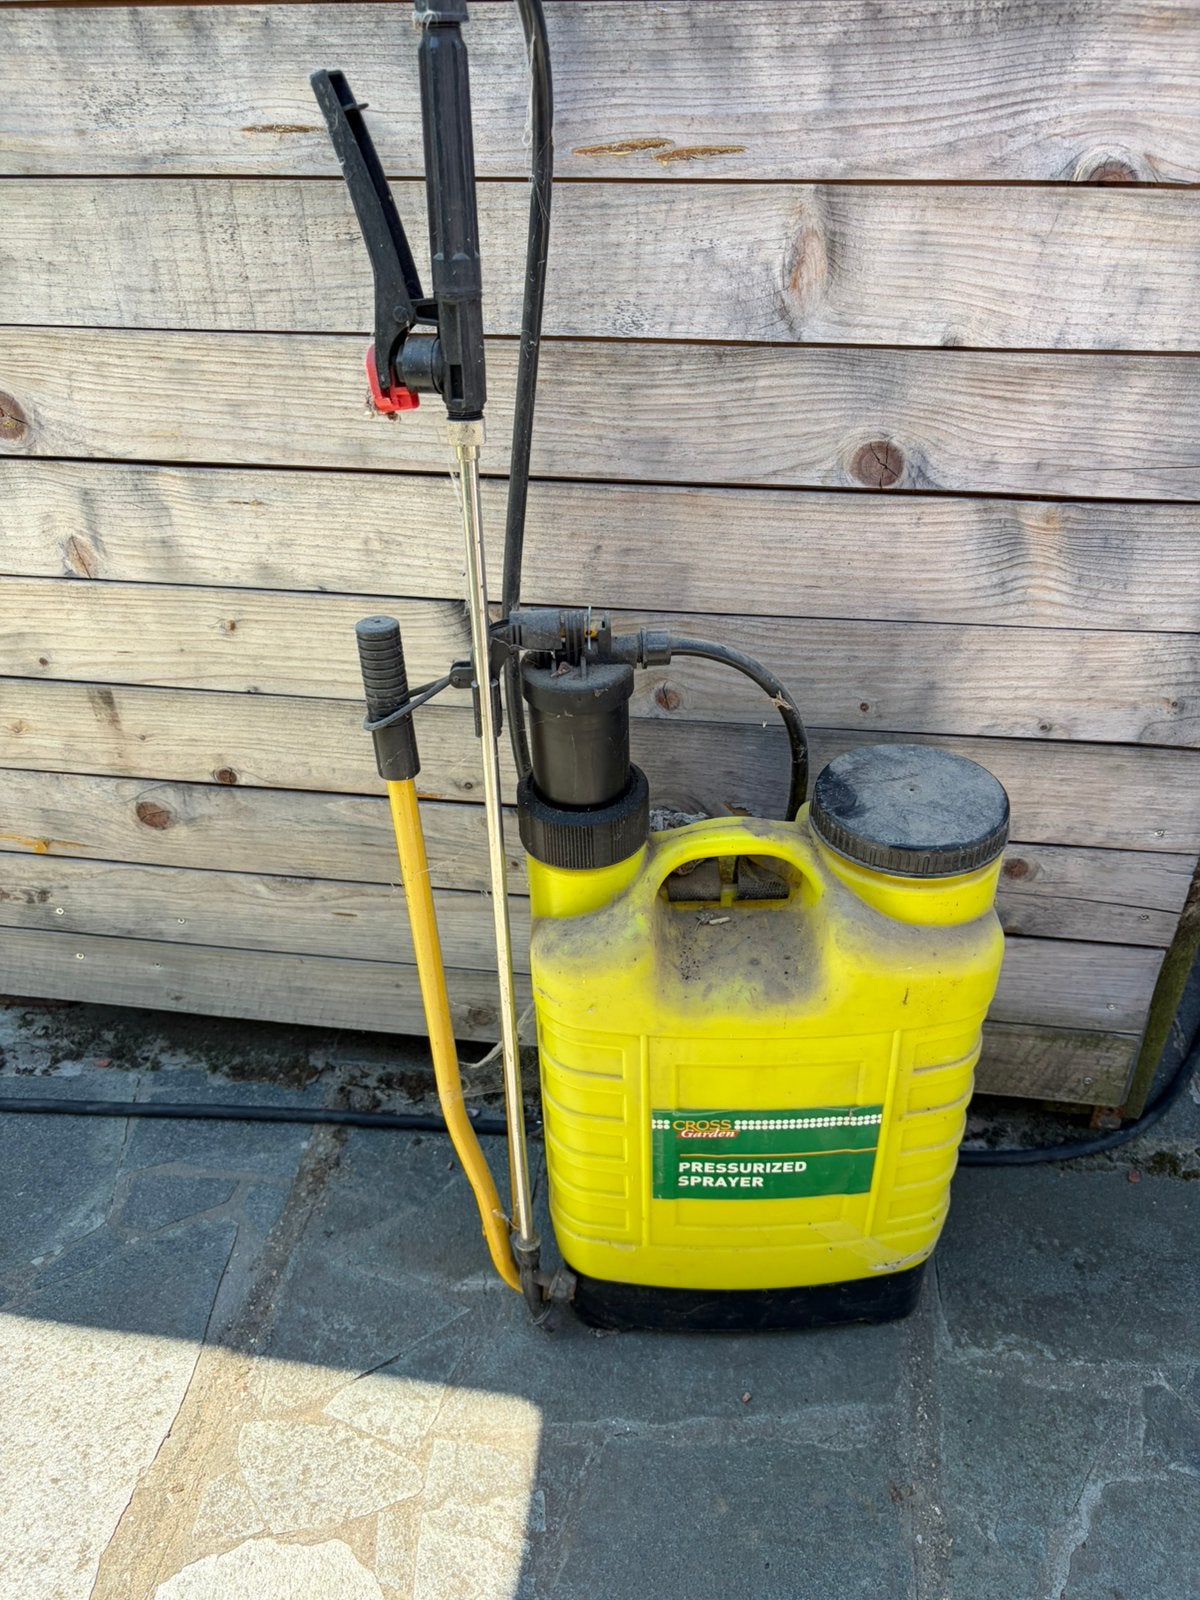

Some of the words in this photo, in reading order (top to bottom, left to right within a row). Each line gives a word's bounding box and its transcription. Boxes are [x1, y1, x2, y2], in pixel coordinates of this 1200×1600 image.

[672, 1119, 732, 1131] CROSS
[681, 1128, 736, 1138] Garden
[678, 1161, 807, 1174] PRESSURIZED
[677, 1175, 764, 1187] SPRAYER
